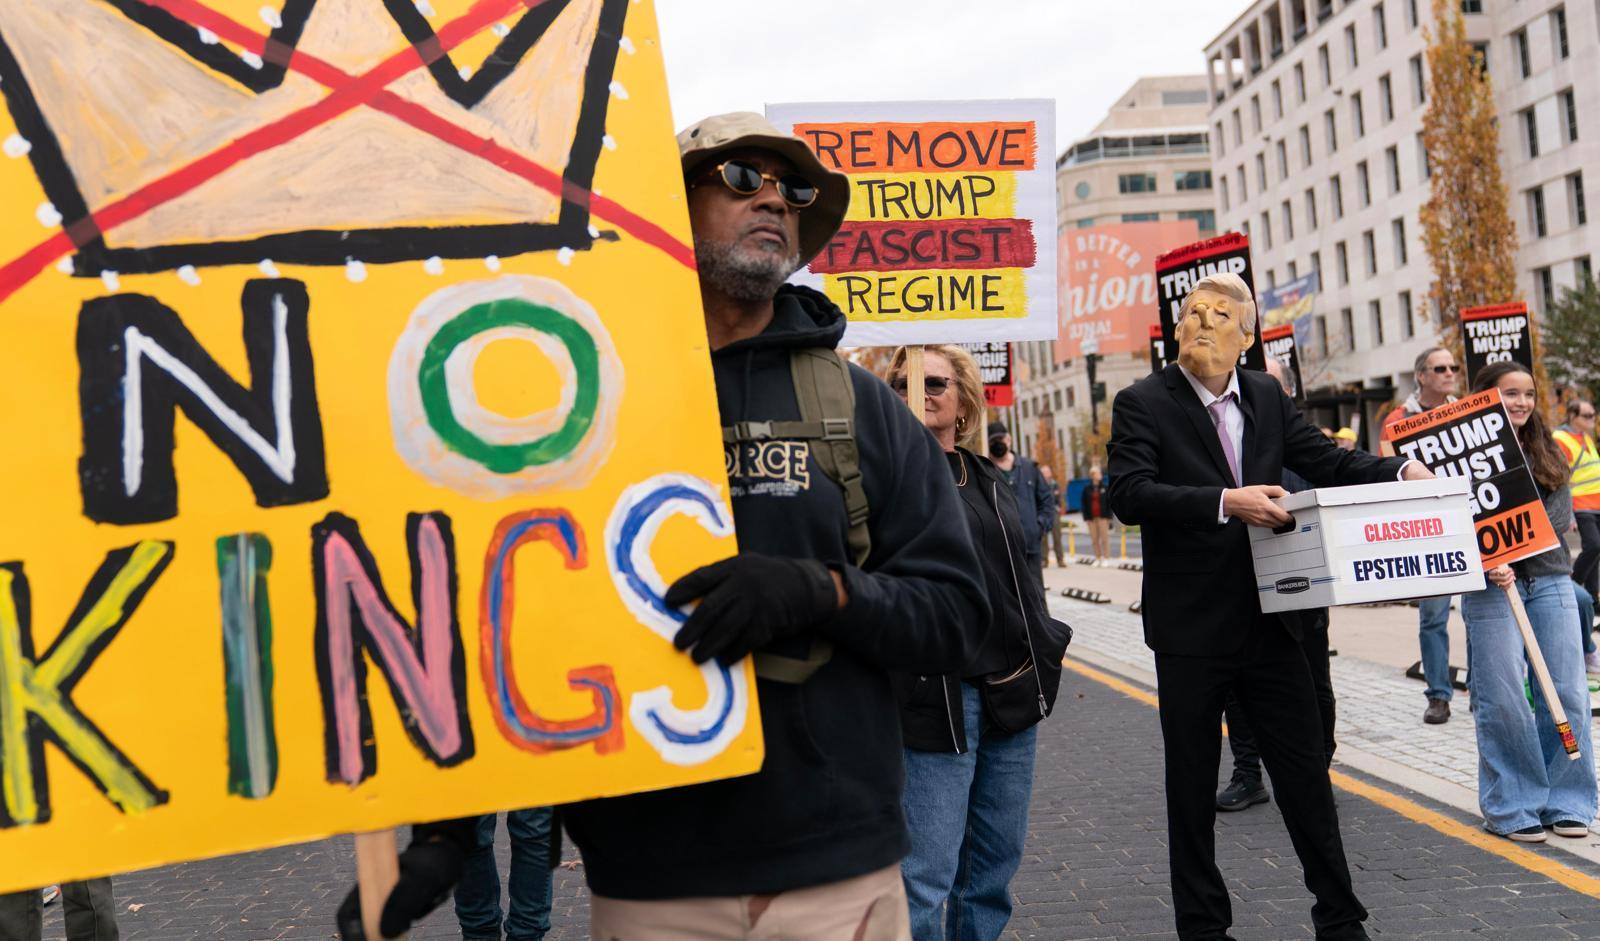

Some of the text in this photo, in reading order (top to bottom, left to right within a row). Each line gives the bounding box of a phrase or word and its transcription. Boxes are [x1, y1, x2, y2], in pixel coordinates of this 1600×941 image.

[805, 128, 1027, 168] REMOVE
[857, 175, 996, 219] TRUMP
[827, 227, 1012, 266] FASCIST
[1076, 233, 1142, 269] BETTER
[837, 275, 1005, 313] REGIME
[1060, 272, 1158, 322] nion
[1465, 316, 1526, 338] TRUMP
[1473, 333, 1522, 354] MUST
[1263, 336, 1294, 358] UMP
[77, 273, 626, 525] NO
[1393, 394, 1491, 434] RefuseFascism.org
[1399, 412, 1504, 465] TRUMP
[725, 441, 810, 490] RCE
[1434, 444, 1506, 480] UST
[1364, 517, 1444, 543] CLASSIFIED
[1477, 511, 1535, 556] OW!
[1353, 551, 1467, 582] EPSTEIN FILES
[0, 473, 748, 827] KINGS
